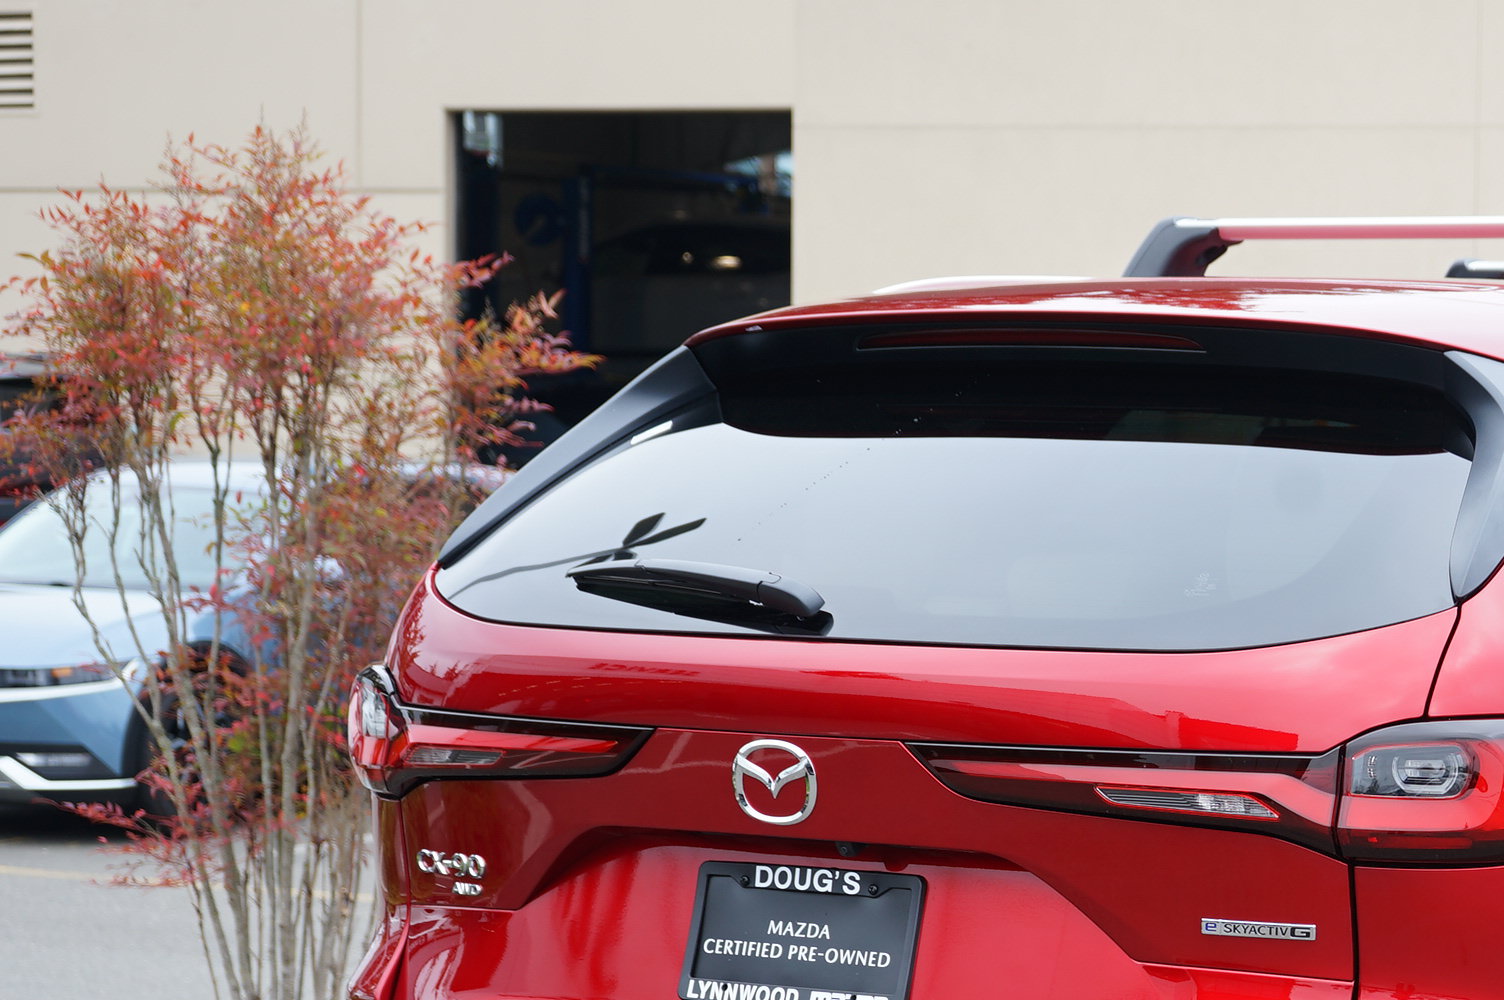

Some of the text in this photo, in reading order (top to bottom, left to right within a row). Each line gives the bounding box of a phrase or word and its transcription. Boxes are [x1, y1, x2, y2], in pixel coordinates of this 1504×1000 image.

[416, 848, 486, 879] CX-90
[452, 881, 483, 896] AWD
[754, 865, 861, 896] DOUG'S
[767, 919, 831, 940] MAZDA
[703, 938, 891, 968] CERTIFIED PRE-OWNED
